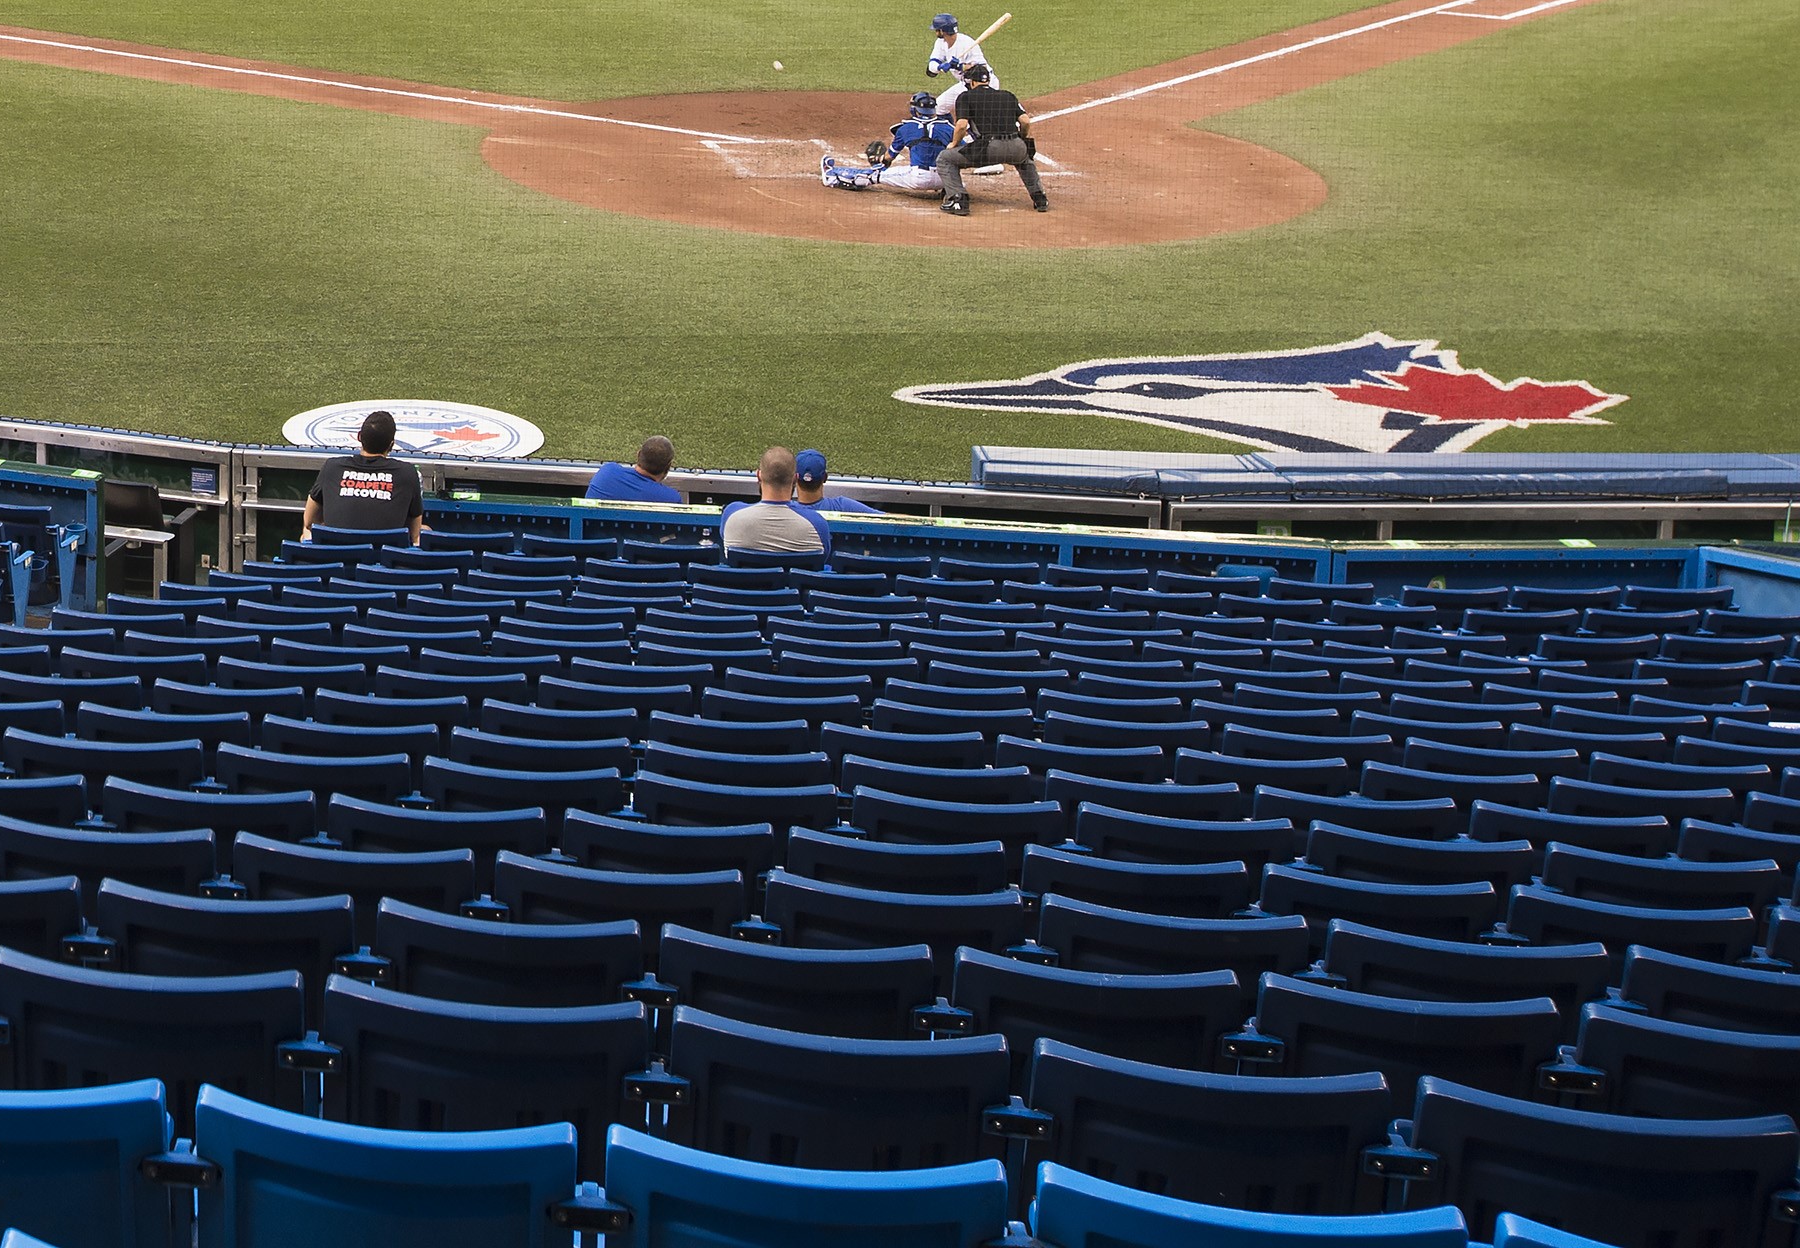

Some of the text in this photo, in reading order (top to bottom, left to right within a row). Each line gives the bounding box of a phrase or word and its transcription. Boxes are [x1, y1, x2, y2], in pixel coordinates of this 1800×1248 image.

[342, 470, 393, 483] PREPARE
[340, 479, 393, 492] COMPETE
[339, 488, 392, 501] RECOVER
